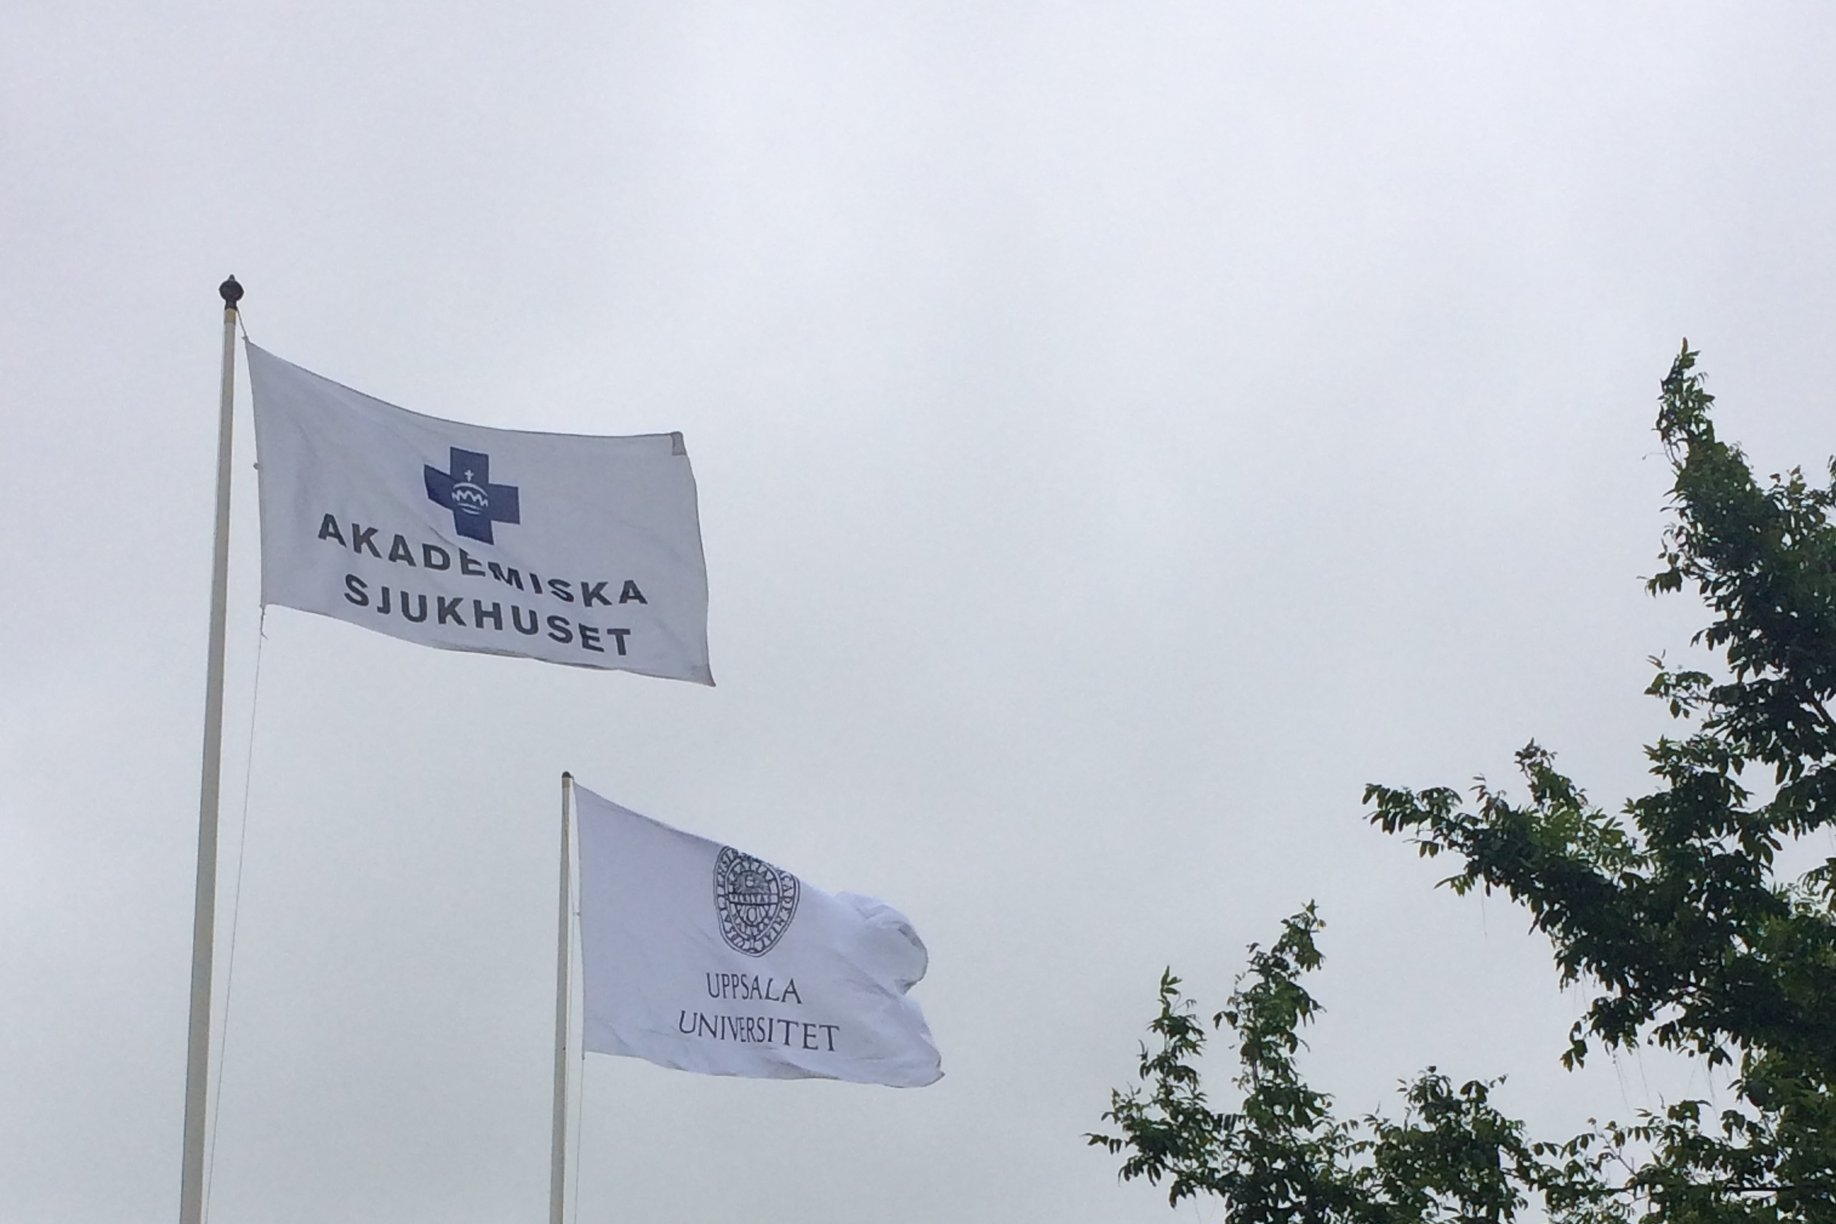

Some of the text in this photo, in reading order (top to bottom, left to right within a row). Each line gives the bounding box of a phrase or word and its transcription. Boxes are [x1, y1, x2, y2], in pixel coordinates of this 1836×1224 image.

[318, 513, 648, 608] AKADEMISKA
[344, 575, 632, 656] SJUKHUSET
[706, 972, 802, 1004] UPPSALA
[679, 1010, 840, 1051] UNIVERSITET
